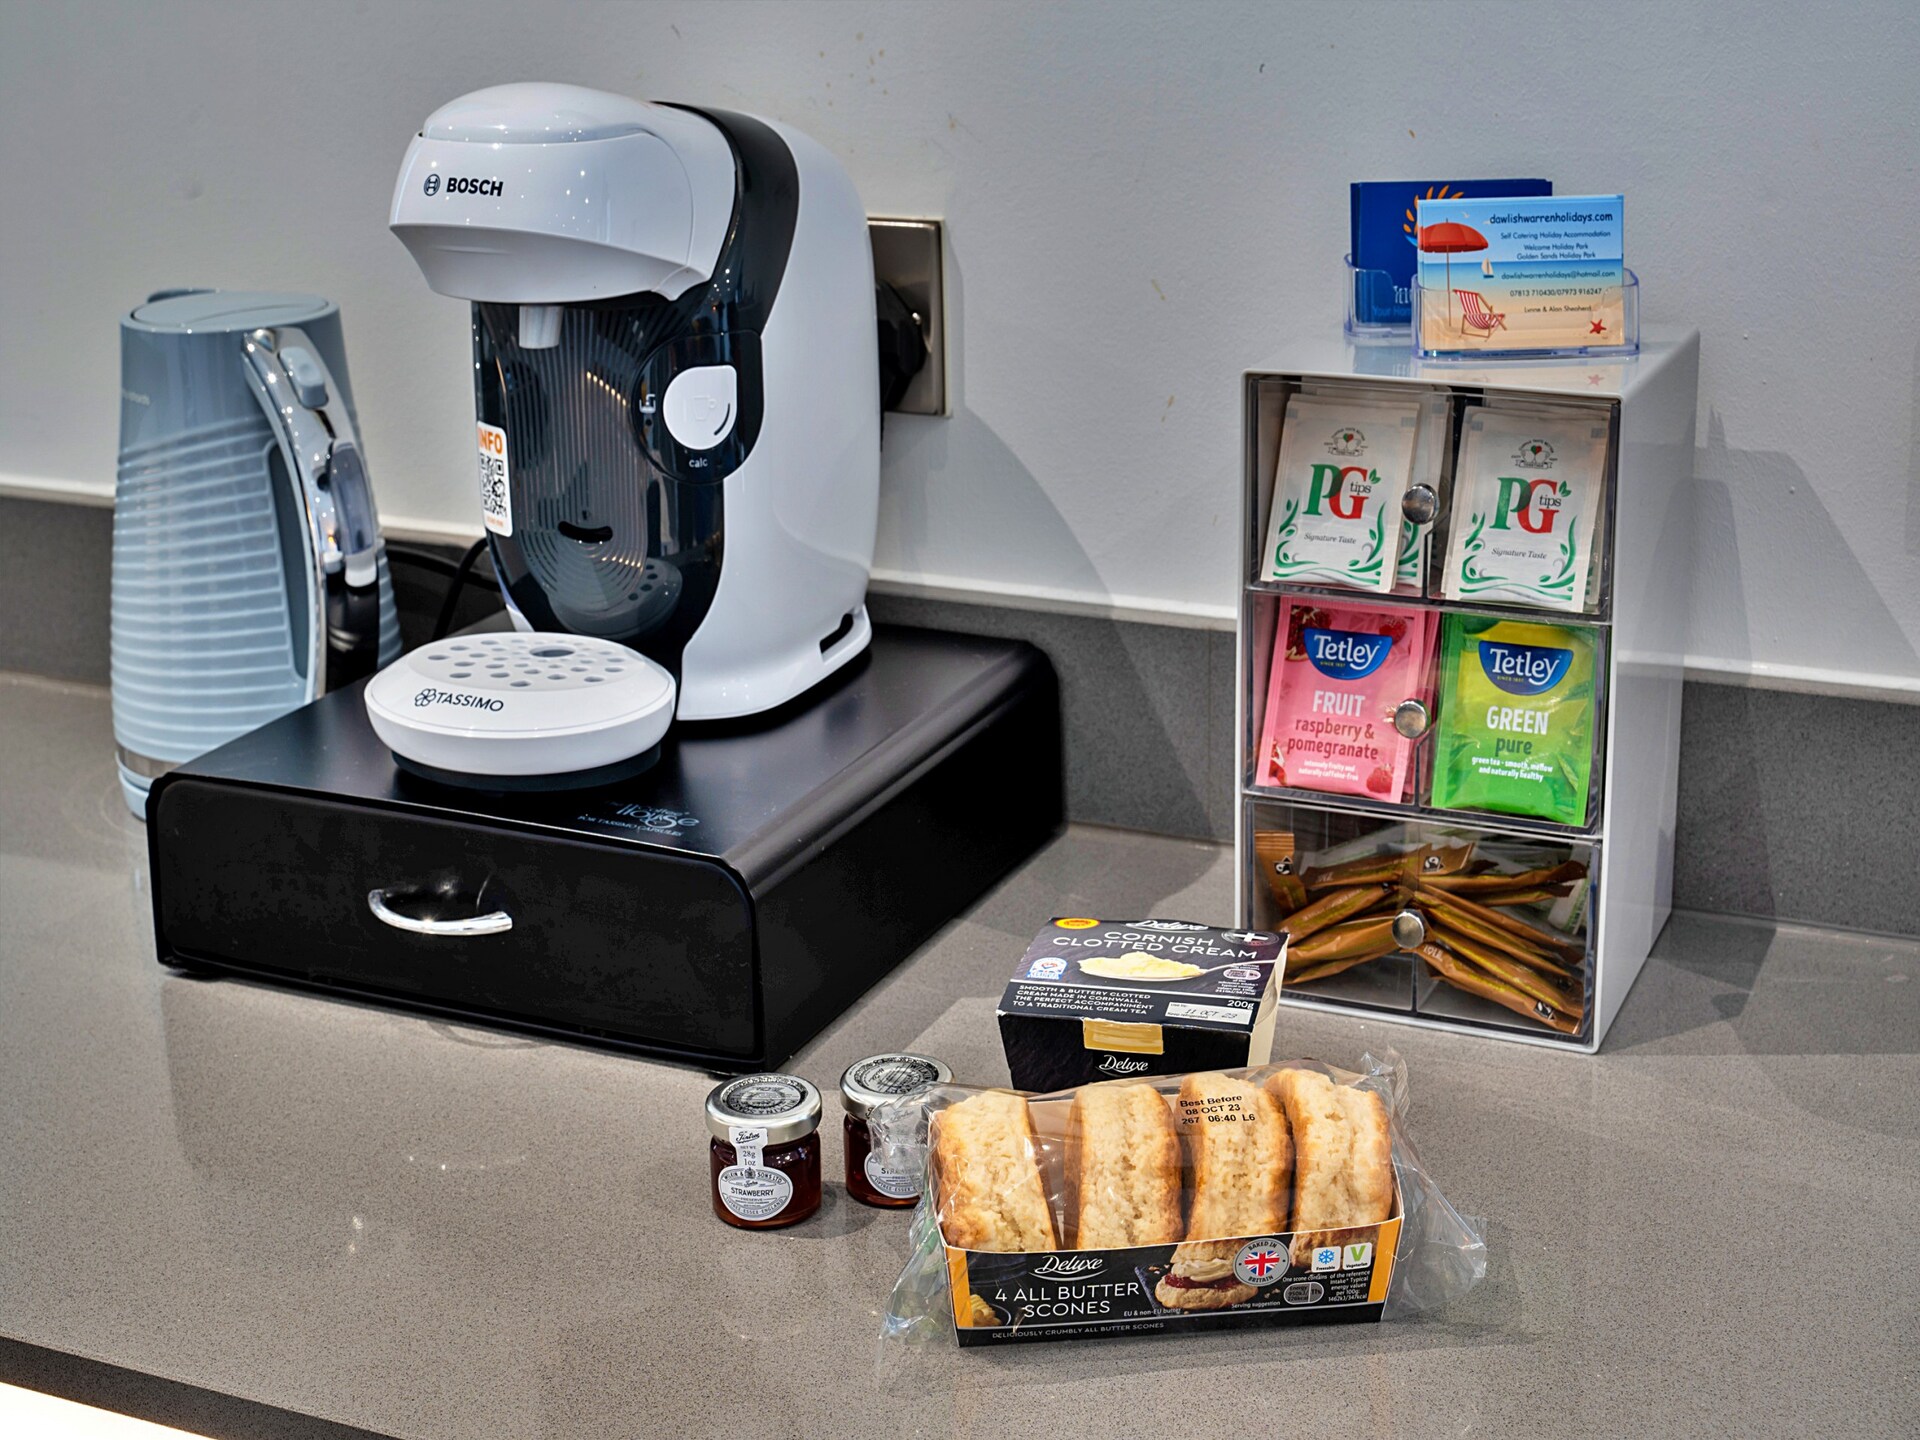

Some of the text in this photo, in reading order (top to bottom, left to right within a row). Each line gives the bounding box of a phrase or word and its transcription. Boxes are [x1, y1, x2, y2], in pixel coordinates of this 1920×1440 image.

[446, 177, 504, 197] BOSCH
[1490, 211, 1613, 225] dawlishwarrenholidays.com
[1501, 230, 1611, 240] Self Catering Holiday Accommodation
[1523, 242, 1589, 251] Welcome Holiday Park
[1517, 252, 1539, 260] Golden
[1560, 251, 1582, 259] Holiday
[1501, 270, 1616, 280] dawlishwarrenholidays@hotmail.com
[1510, 288, 1603, 297] 07813 710430/07973 916247
[688, 457, 708, 468] calc
[1302, 464, 1372, 520] PG tips
[1489, 477, 1562, 534] PG tips
[1304, 533, 1357, 544] Signature Taste
[1491, 548, 1548, 559] Signature Taste
[1314, 634, 1381, 670] Tetley
[1490, 647, 1560, 685] Tetley
[436, 692, 504, 712] TASSIMO
[1312, 690, 1367, 717] FRUIT
[1486, 705, 1549, 735] GREEN
[1295, 717, 1375, 742] raspberry &
[1287, 737, 1379, 760] pomegranate
[1495, 736, 1533, 757] pure
[1472, 756, 1489, 766] green
[1490, 757, 1500, 766] tea
[1479, 766, 1544, 783] and naturally healthy
[1125, 919, 1209, 931] Deluxe
[1104, 931, 1214, 946] CORNISH
[1052, 936, 1258, 959] CLOTTED CREAM
[1019, 984, 1058, 993] SMOOTH
[1068, 988, 1108, 996] BUTTERY
[1109, 991, 1151, 999] CLOTTED
[1049, 991, 1075, 999] MADE
[1088, 994, 1142, 1005] CORNWALL,
[1033, 995, 1073, 1004] PERFECT
[1074, 999, 1155, 1010] ACCOMPANIMENT
[1035, 1002, 1094, 1011] TRADITIONAL
[1096, 1005, 1128, 1014] CREAM
[1227, 999, 1255, 1010] 200g
[1099, 1054, 1149, 1073] Deluxe
[1180, 1095, 1242, 1107] Best Before
[1201, 1105, 1225, 1114] OCT
[1228, 1103, 1241, 1111] 23
[1182, 1113, 1256, 1125] 267 06:40 L6
[743, 1150, 756, 1159] 28g
[744, 1158, 756, 1166] 1oz
[731, 1187, 774, 1197] STRAWBERRY
[1248, 1241, 1278, 1251] BAKED IN
[1350, 1245, 1366, 1262] V
[1034, 1255, 1103, 1275] Deluxe
[1248, 1275, 1274, 1283] BRITAIN
[1346, 1270, 1371, 1278] reference
[995, 1282, 1139, 1302] 4 ALL BUTTER
[1023, 1300, 1110, 1318] SCONES
[1140, 1308, 1162, 1316] non-EU
[1252, 1301, 1280, 1309] suggestion
[992, 1330, 1043, 1339] DELICIOUSLY
[1045, 1327, 1083, 1336] CRUMBLY
[1100, 1324, 1131, 1332] BUTTER
[1132, 1322, 1165, 1331] SCONES
